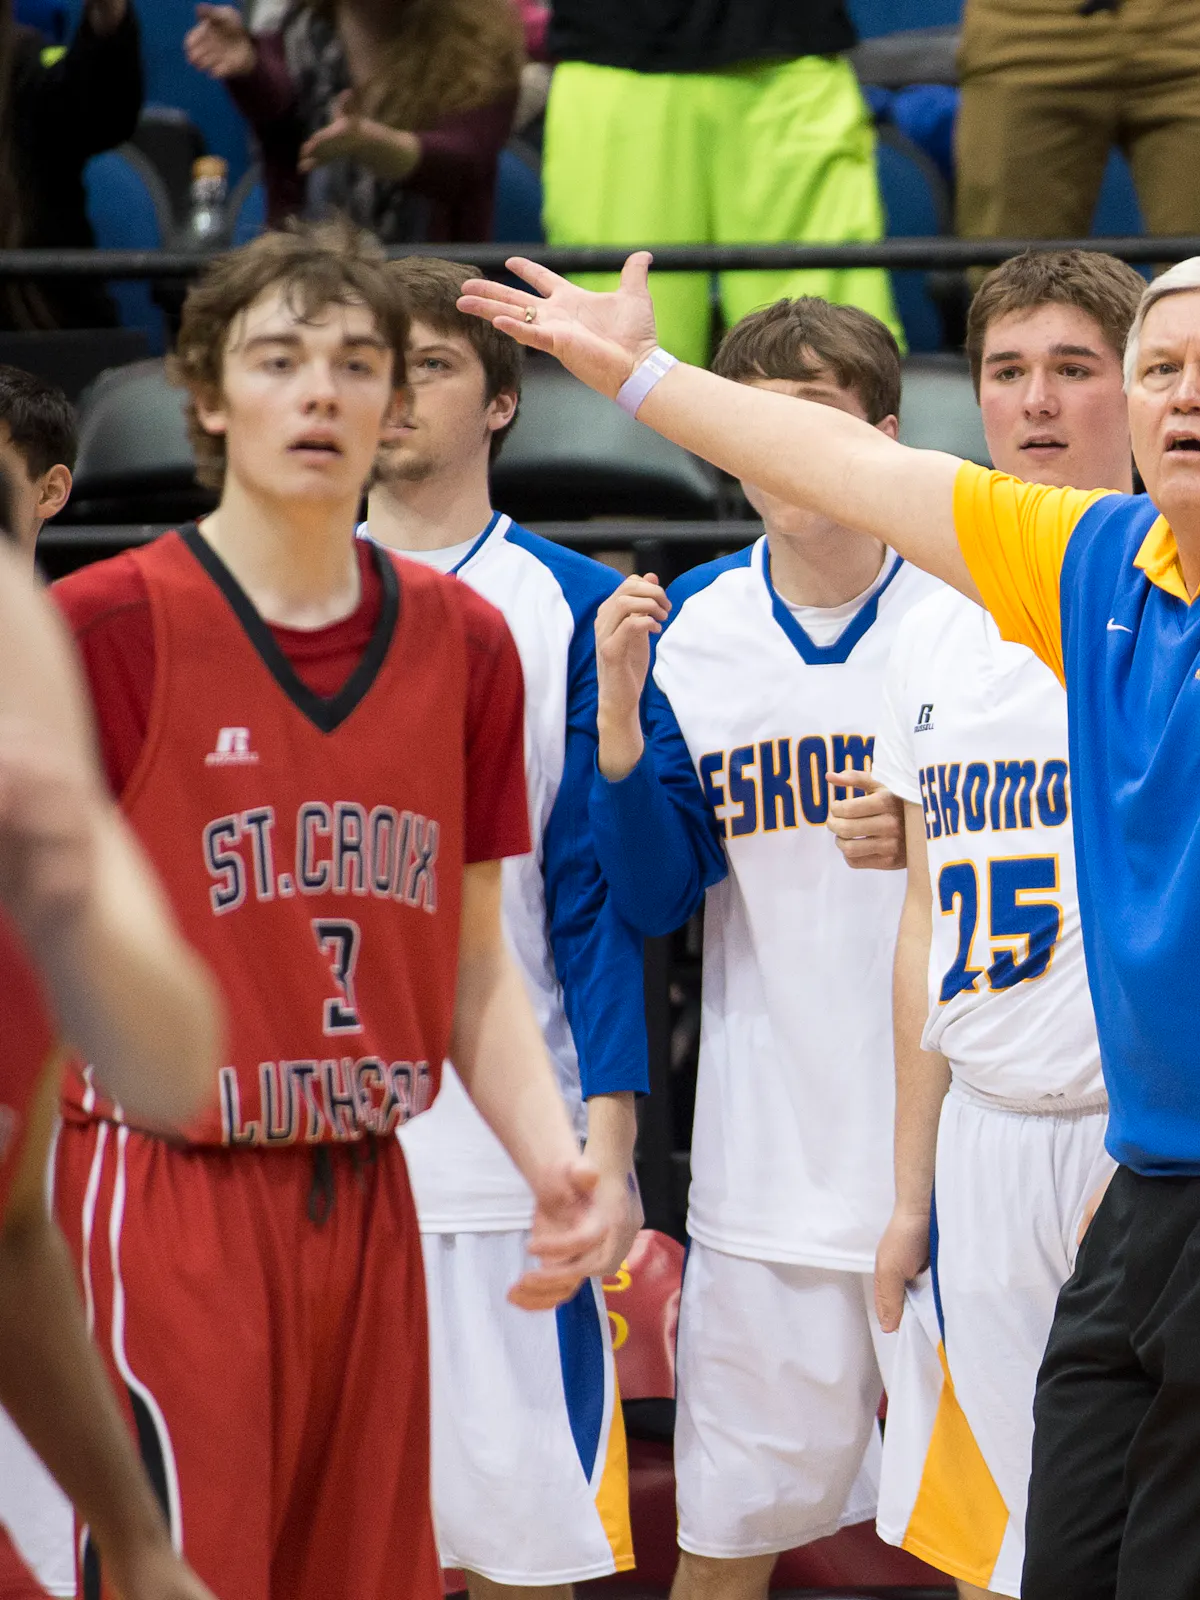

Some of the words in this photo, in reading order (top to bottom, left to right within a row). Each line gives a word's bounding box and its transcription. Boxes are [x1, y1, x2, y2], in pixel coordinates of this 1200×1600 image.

[699, 733, 875, 840] ESKOM
[919, 758, 1069, 841] ESKOMO
[312, 918, 363, 1036] 3
[938, 853, 1064, 1006] 25
